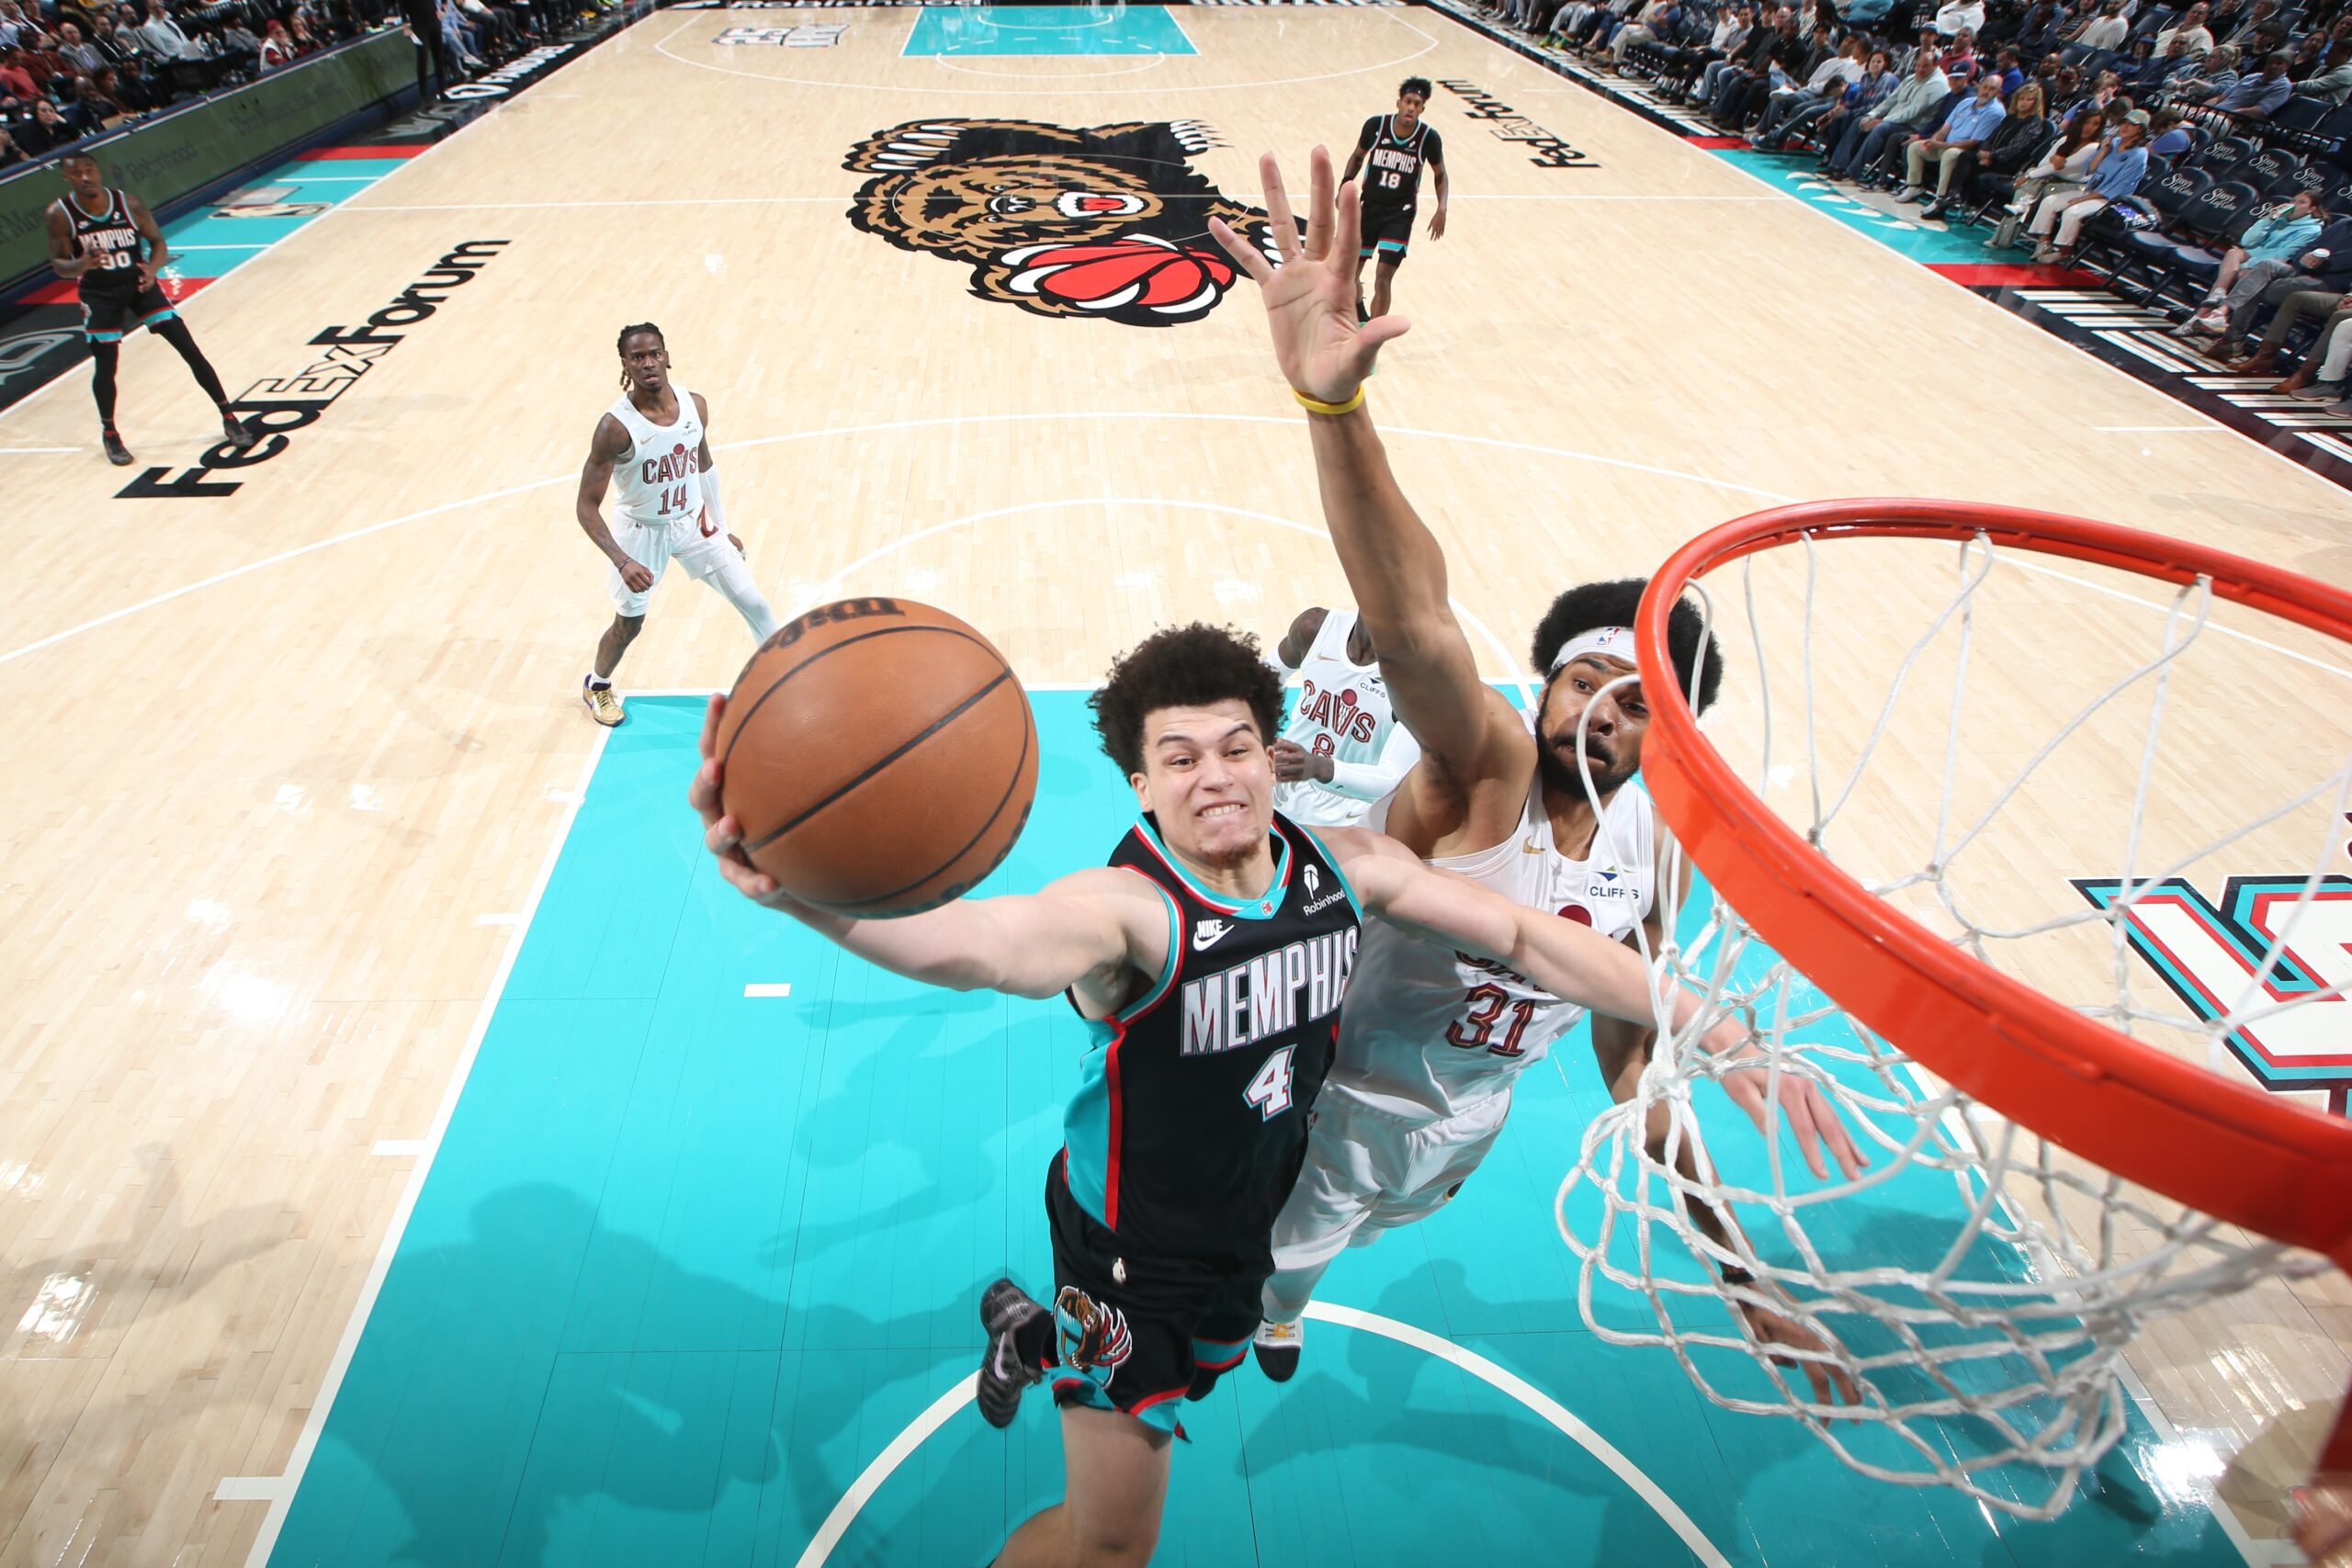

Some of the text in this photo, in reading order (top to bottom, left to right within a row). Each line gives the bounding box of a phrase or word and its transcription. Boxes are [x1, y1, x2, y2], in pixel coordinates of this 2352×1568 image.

[1436, 80, 1602, 168] FedExForum
[1373, 149, 1417, 175] MEMPHIS
[1379, 171, 1401, 189] 18
[78, 228, 137, 252] MEMPHIS
[112, 240, 512, 498] FedExForum
[642, 446, 699, 485] CAVS
[658, 483, 688, 515] 14
[1360, 682, 1386, 699] CLIFFS
[1299, 679, 1376, 744] CAVS
[1303, 887, 1346, 917] Robinhood
[1197, 919, 1223, 939] NIKE
[1180, 925, 1358, 1057] MEMPHIS
[1445, 982, 1537, 1057] 31
[1242, 1043, 1297, 1122] 4
